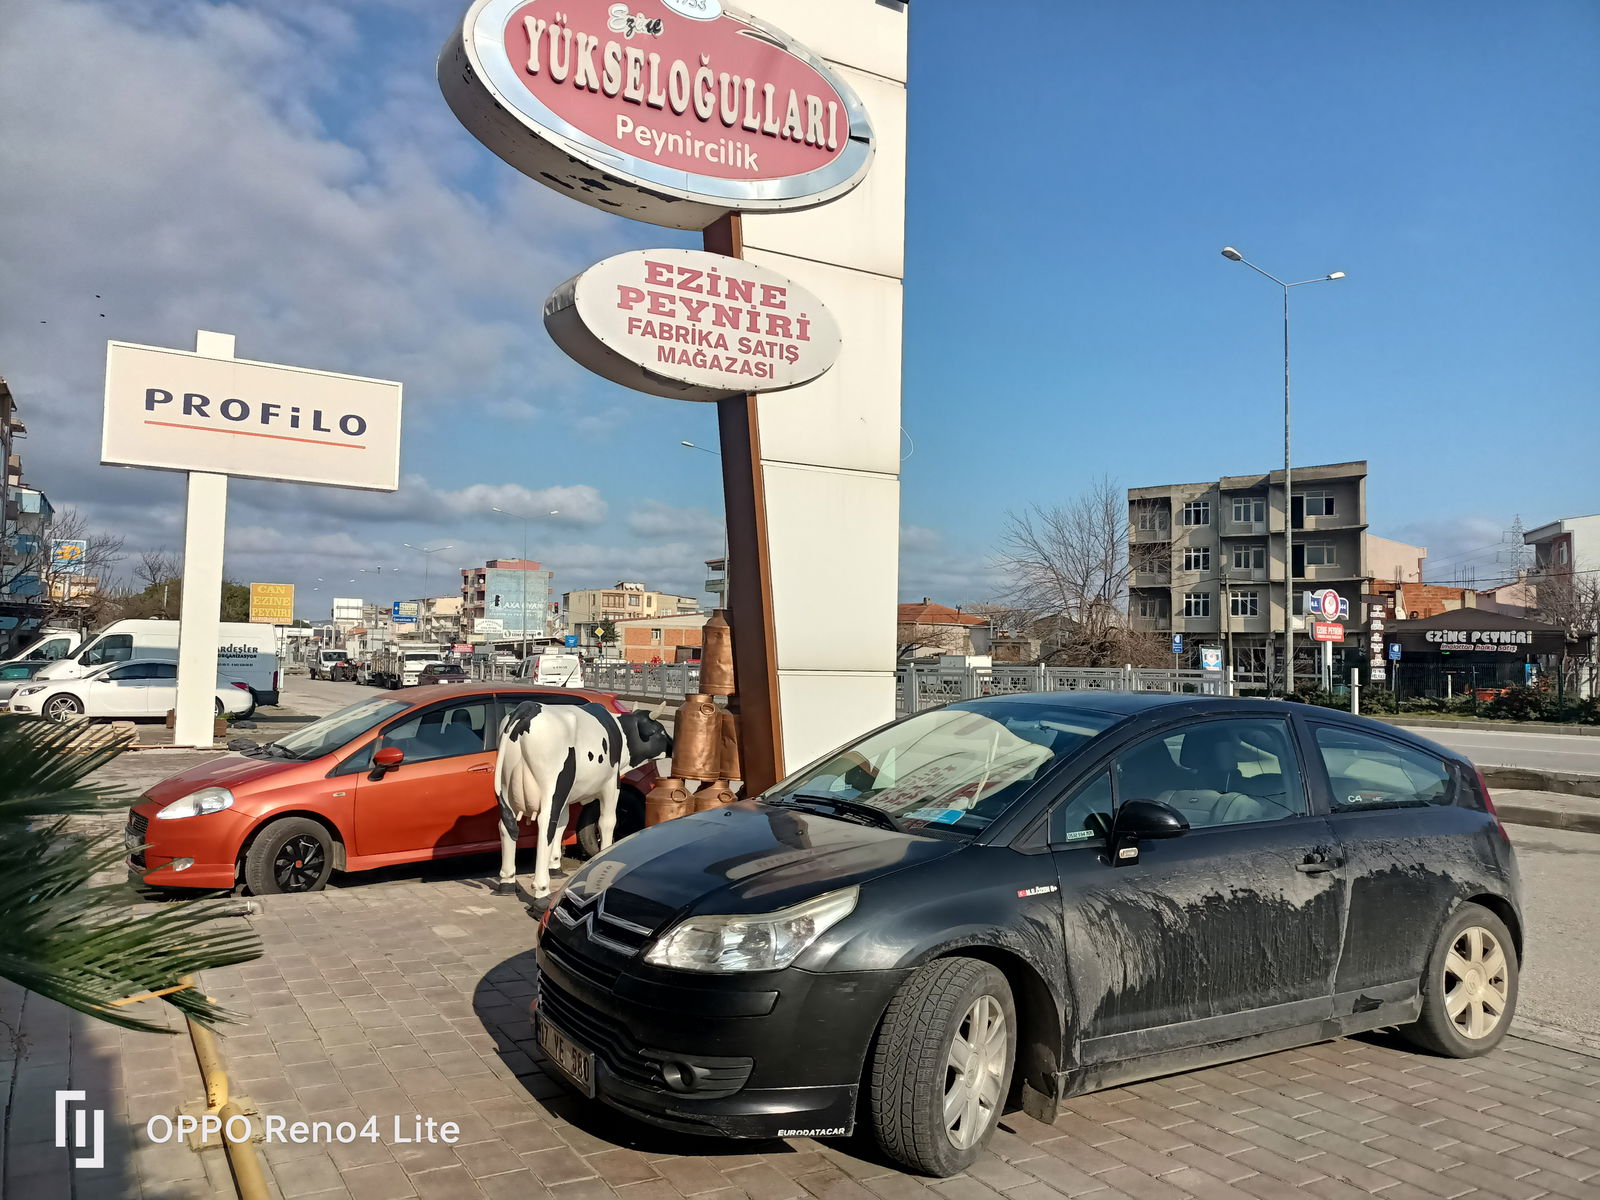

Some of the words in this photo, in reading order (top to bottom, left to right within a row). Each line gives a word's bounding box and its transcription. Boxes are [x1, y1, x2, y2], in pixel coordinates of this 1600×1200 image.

[523, 11, 838, 151] YÜKSELOĞULLARI
[616, 114, 759, 172] Peynircilik
[645, 260, 787, 310] EZİNE
[617, 285, 810, 341] PEYNİRİ
[627, 316, 729, 351] FABRİKA
[738, 337, 799, 365] SATIŞ
[657, 345, 774, 379] MAĞAZASI
[257, 585, 286, 594] CAN
[540, 1020, 548, 1047] 17
[777, 1127, 846, 1137] EURODATACAR
